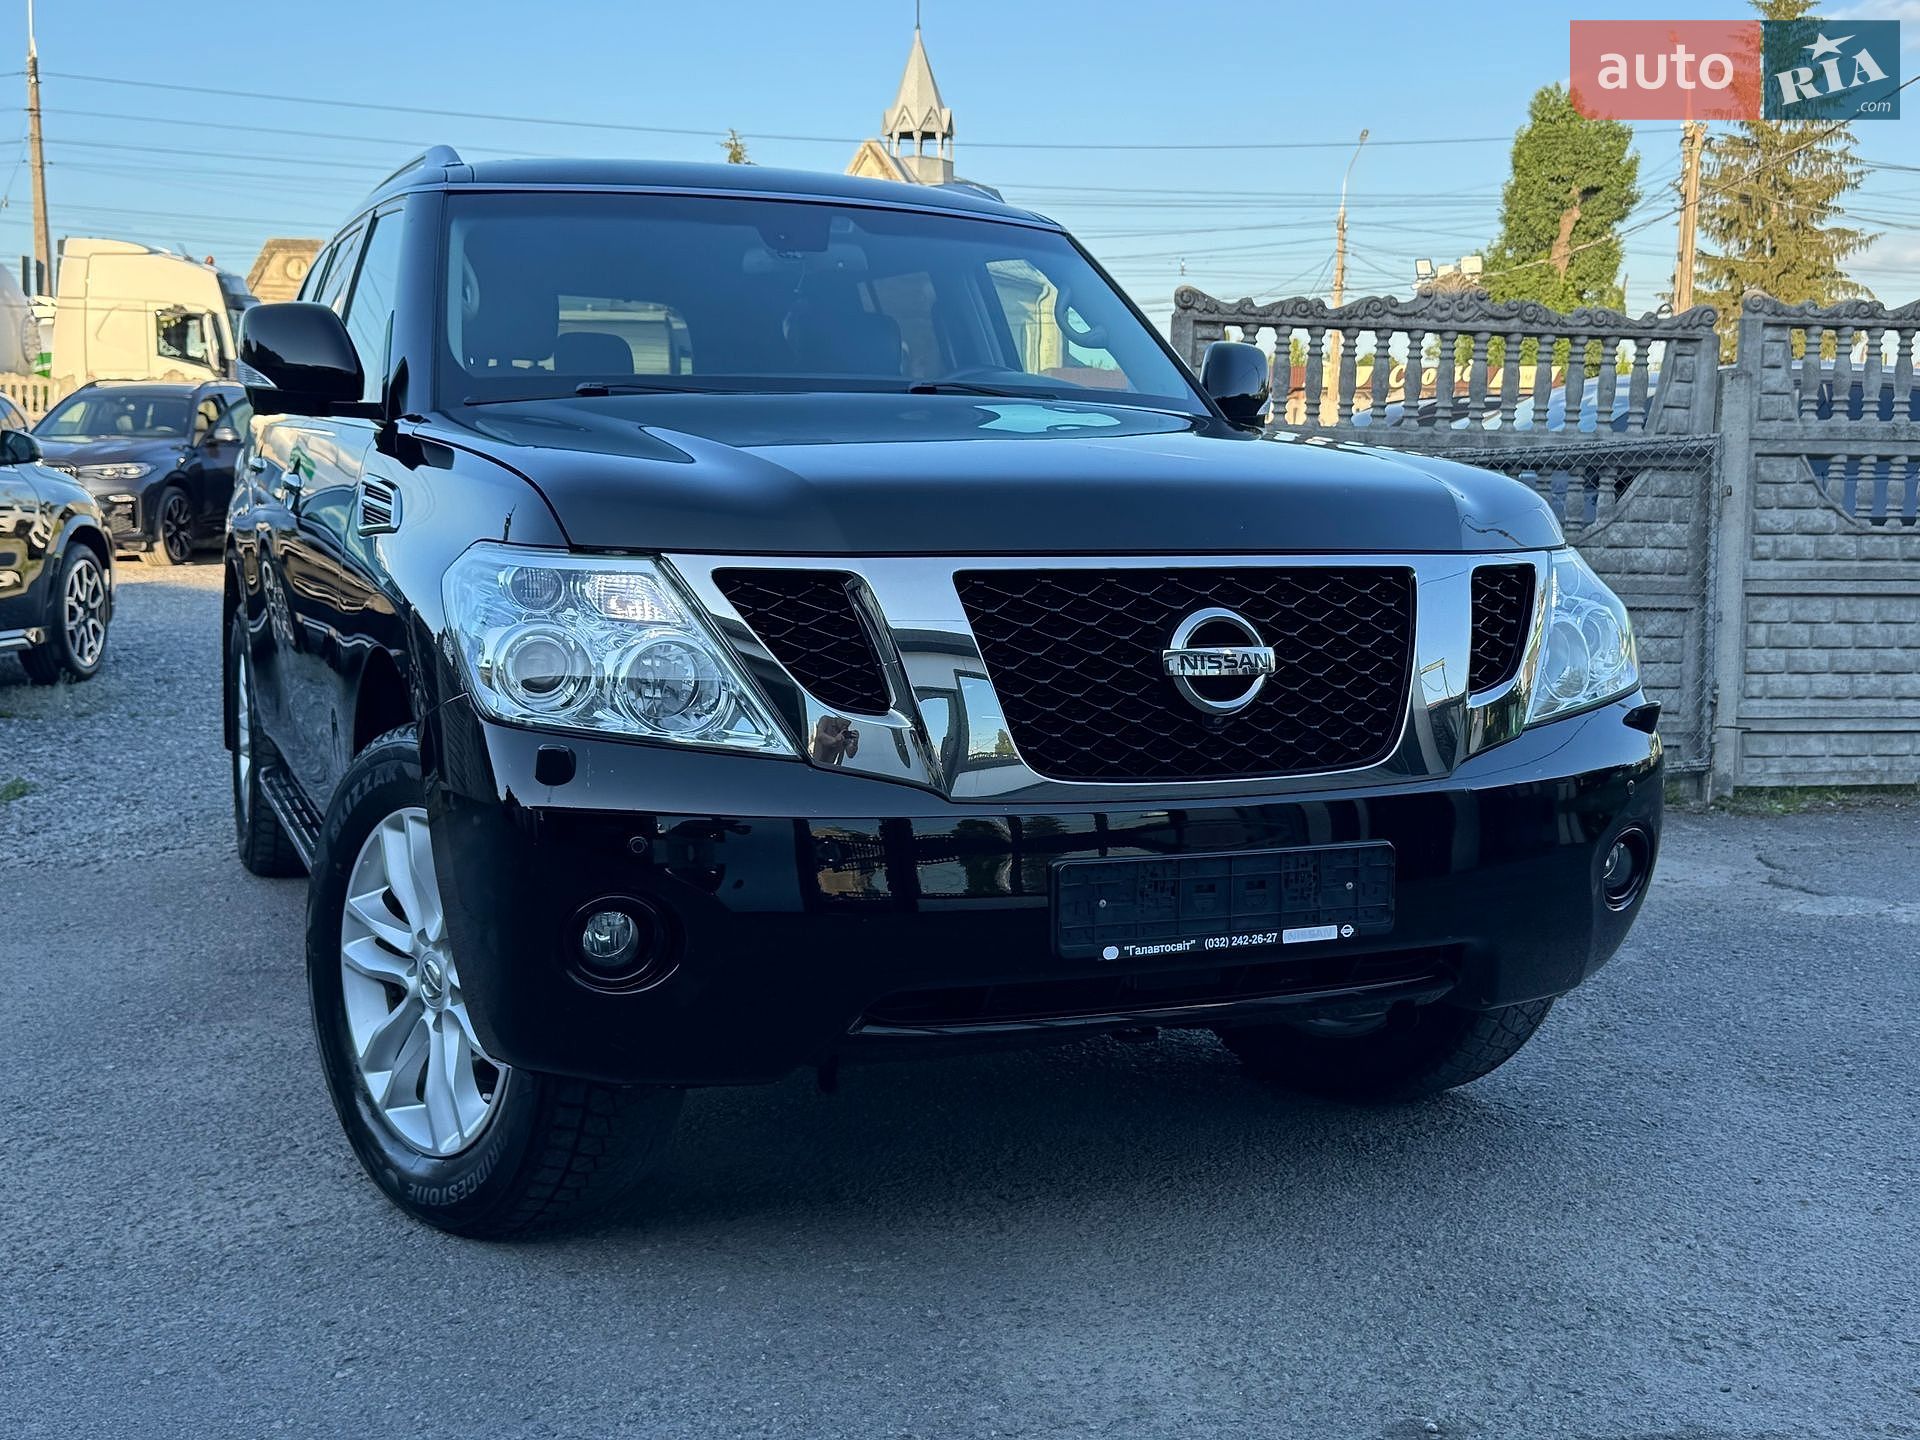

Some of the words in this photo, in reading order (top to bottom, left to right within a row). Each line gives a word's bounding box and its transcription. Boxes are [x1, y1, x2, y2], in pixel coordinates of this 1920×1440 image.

[1180, 652, 1268, 671] NISSAN
[1124, 939, 1196, 956] "Галавтосвіт"
[1204, 937, 1229, 950] (032)
[1231, 932, 1278, 947] 242-26-27
